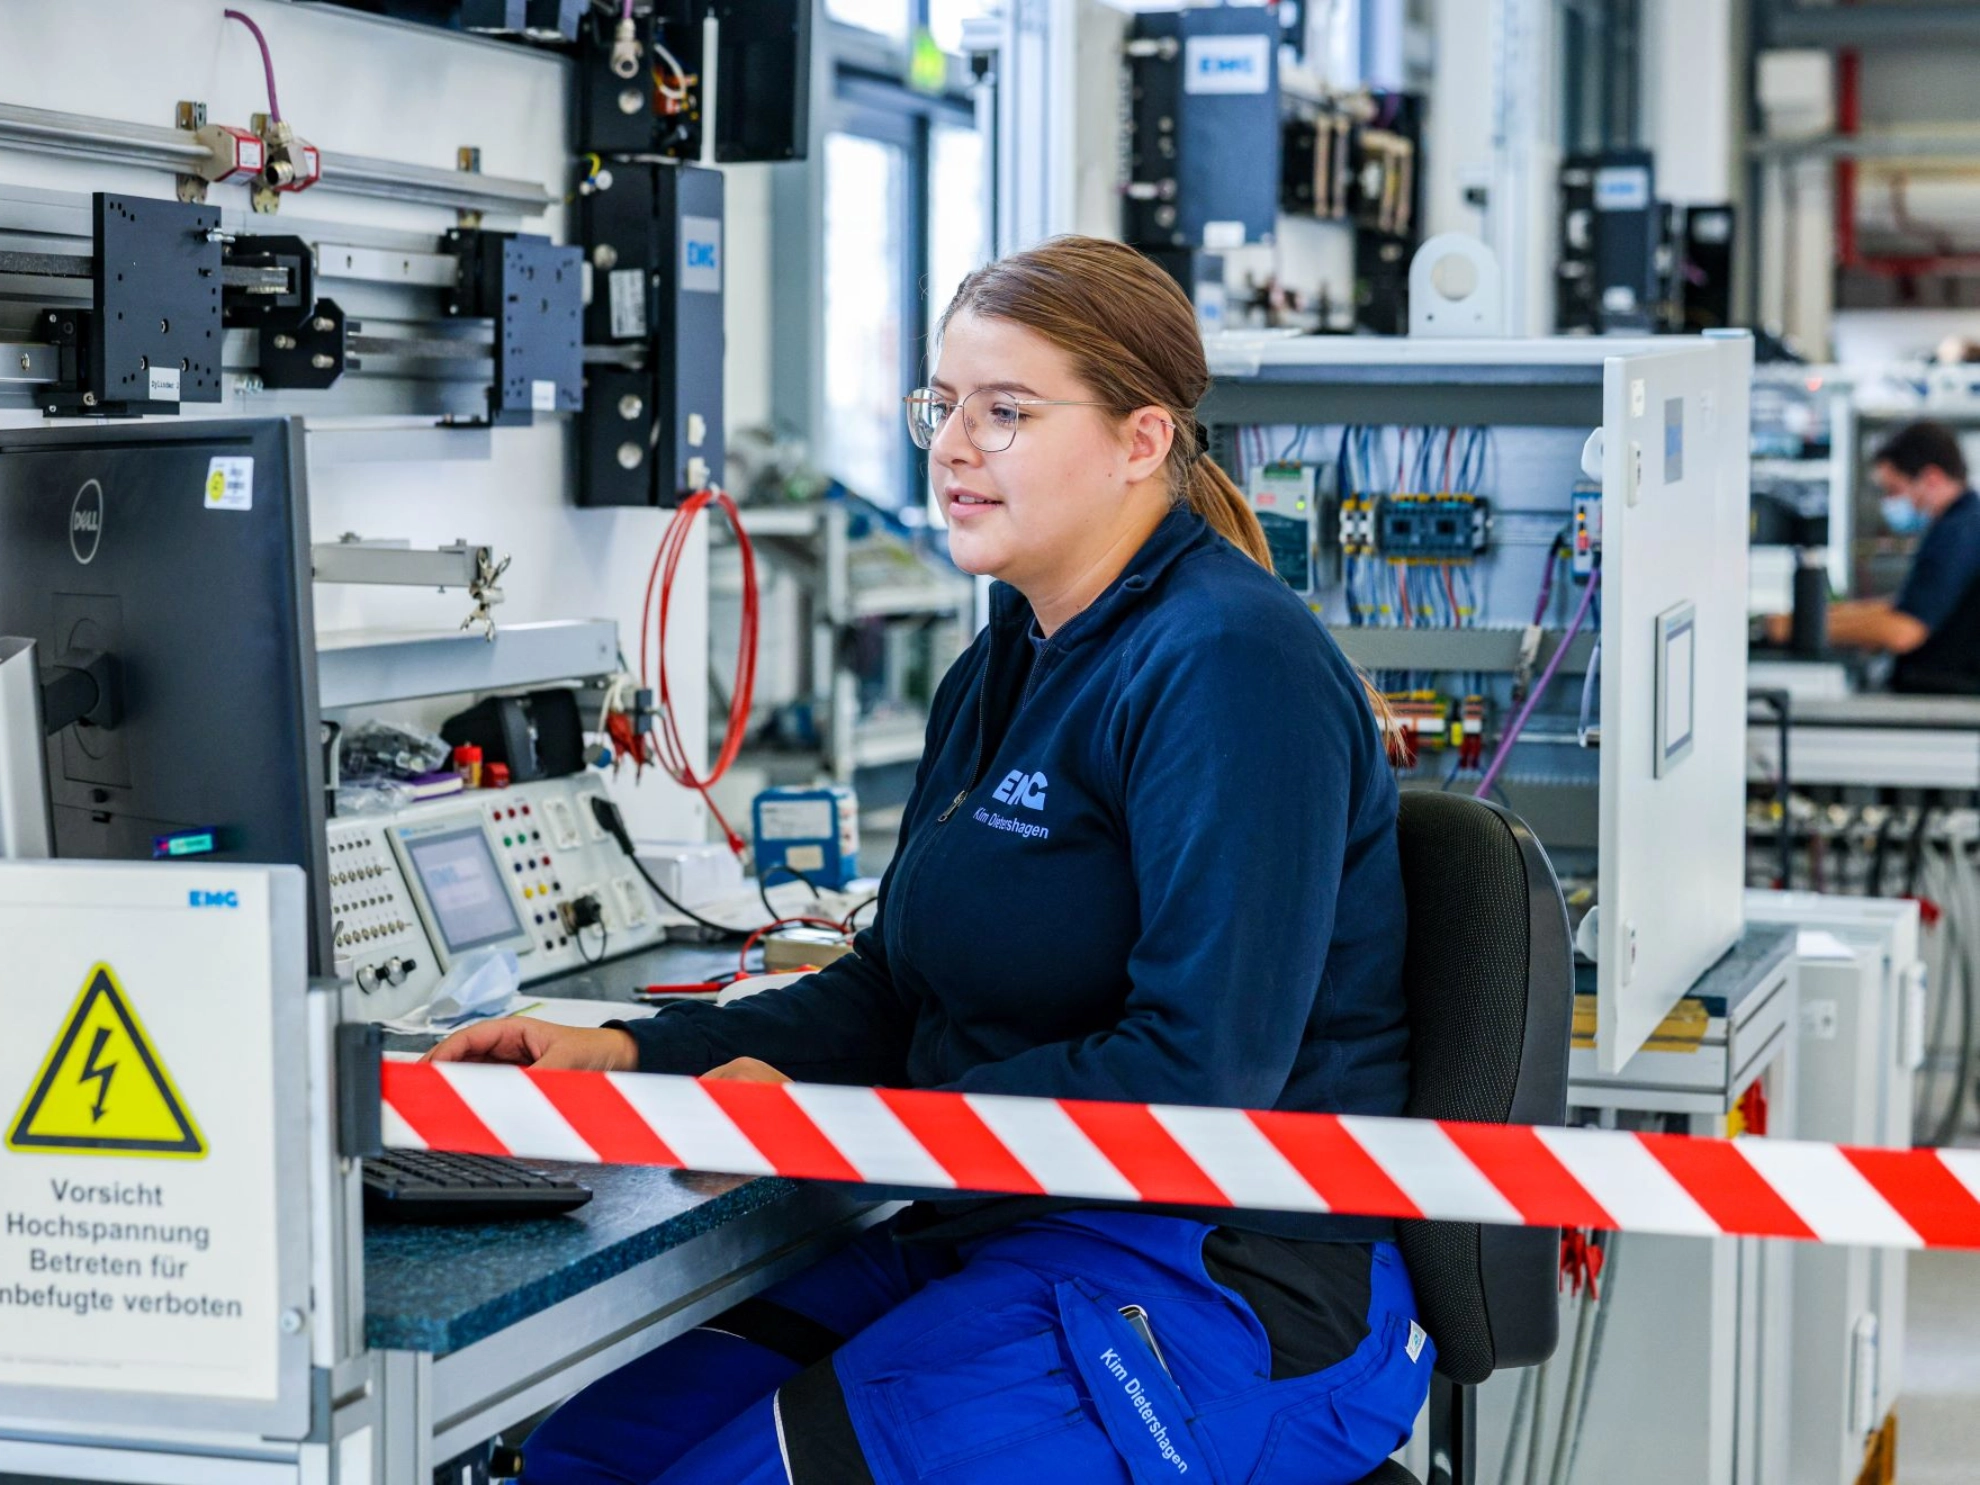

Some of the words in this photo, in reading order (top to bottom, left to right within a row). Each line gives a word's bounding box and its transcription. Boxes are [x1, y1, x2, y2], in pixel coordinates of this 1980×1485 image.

[73, 510, 98, 531] DELL
[972, 806, 989, 823] Kim
[987, 812, 1050, 840] Dietershagen
[189, 890, 238, 908] EMG
[51, 1178, 163, 1207] Vorsicht
[6, 1211, 210, 1251] Hochspannung
[29, 1247, 142, 1277] Betreten
[151, 1254, 188, 1279] für
[0, 1282, 114, 1316] nbefugte
[122, 1291, 243, 1318] verboten
[1099, 1347, 1128, 1382] Kim
[1124, 1377, 1188, 1475] Dietershagen
